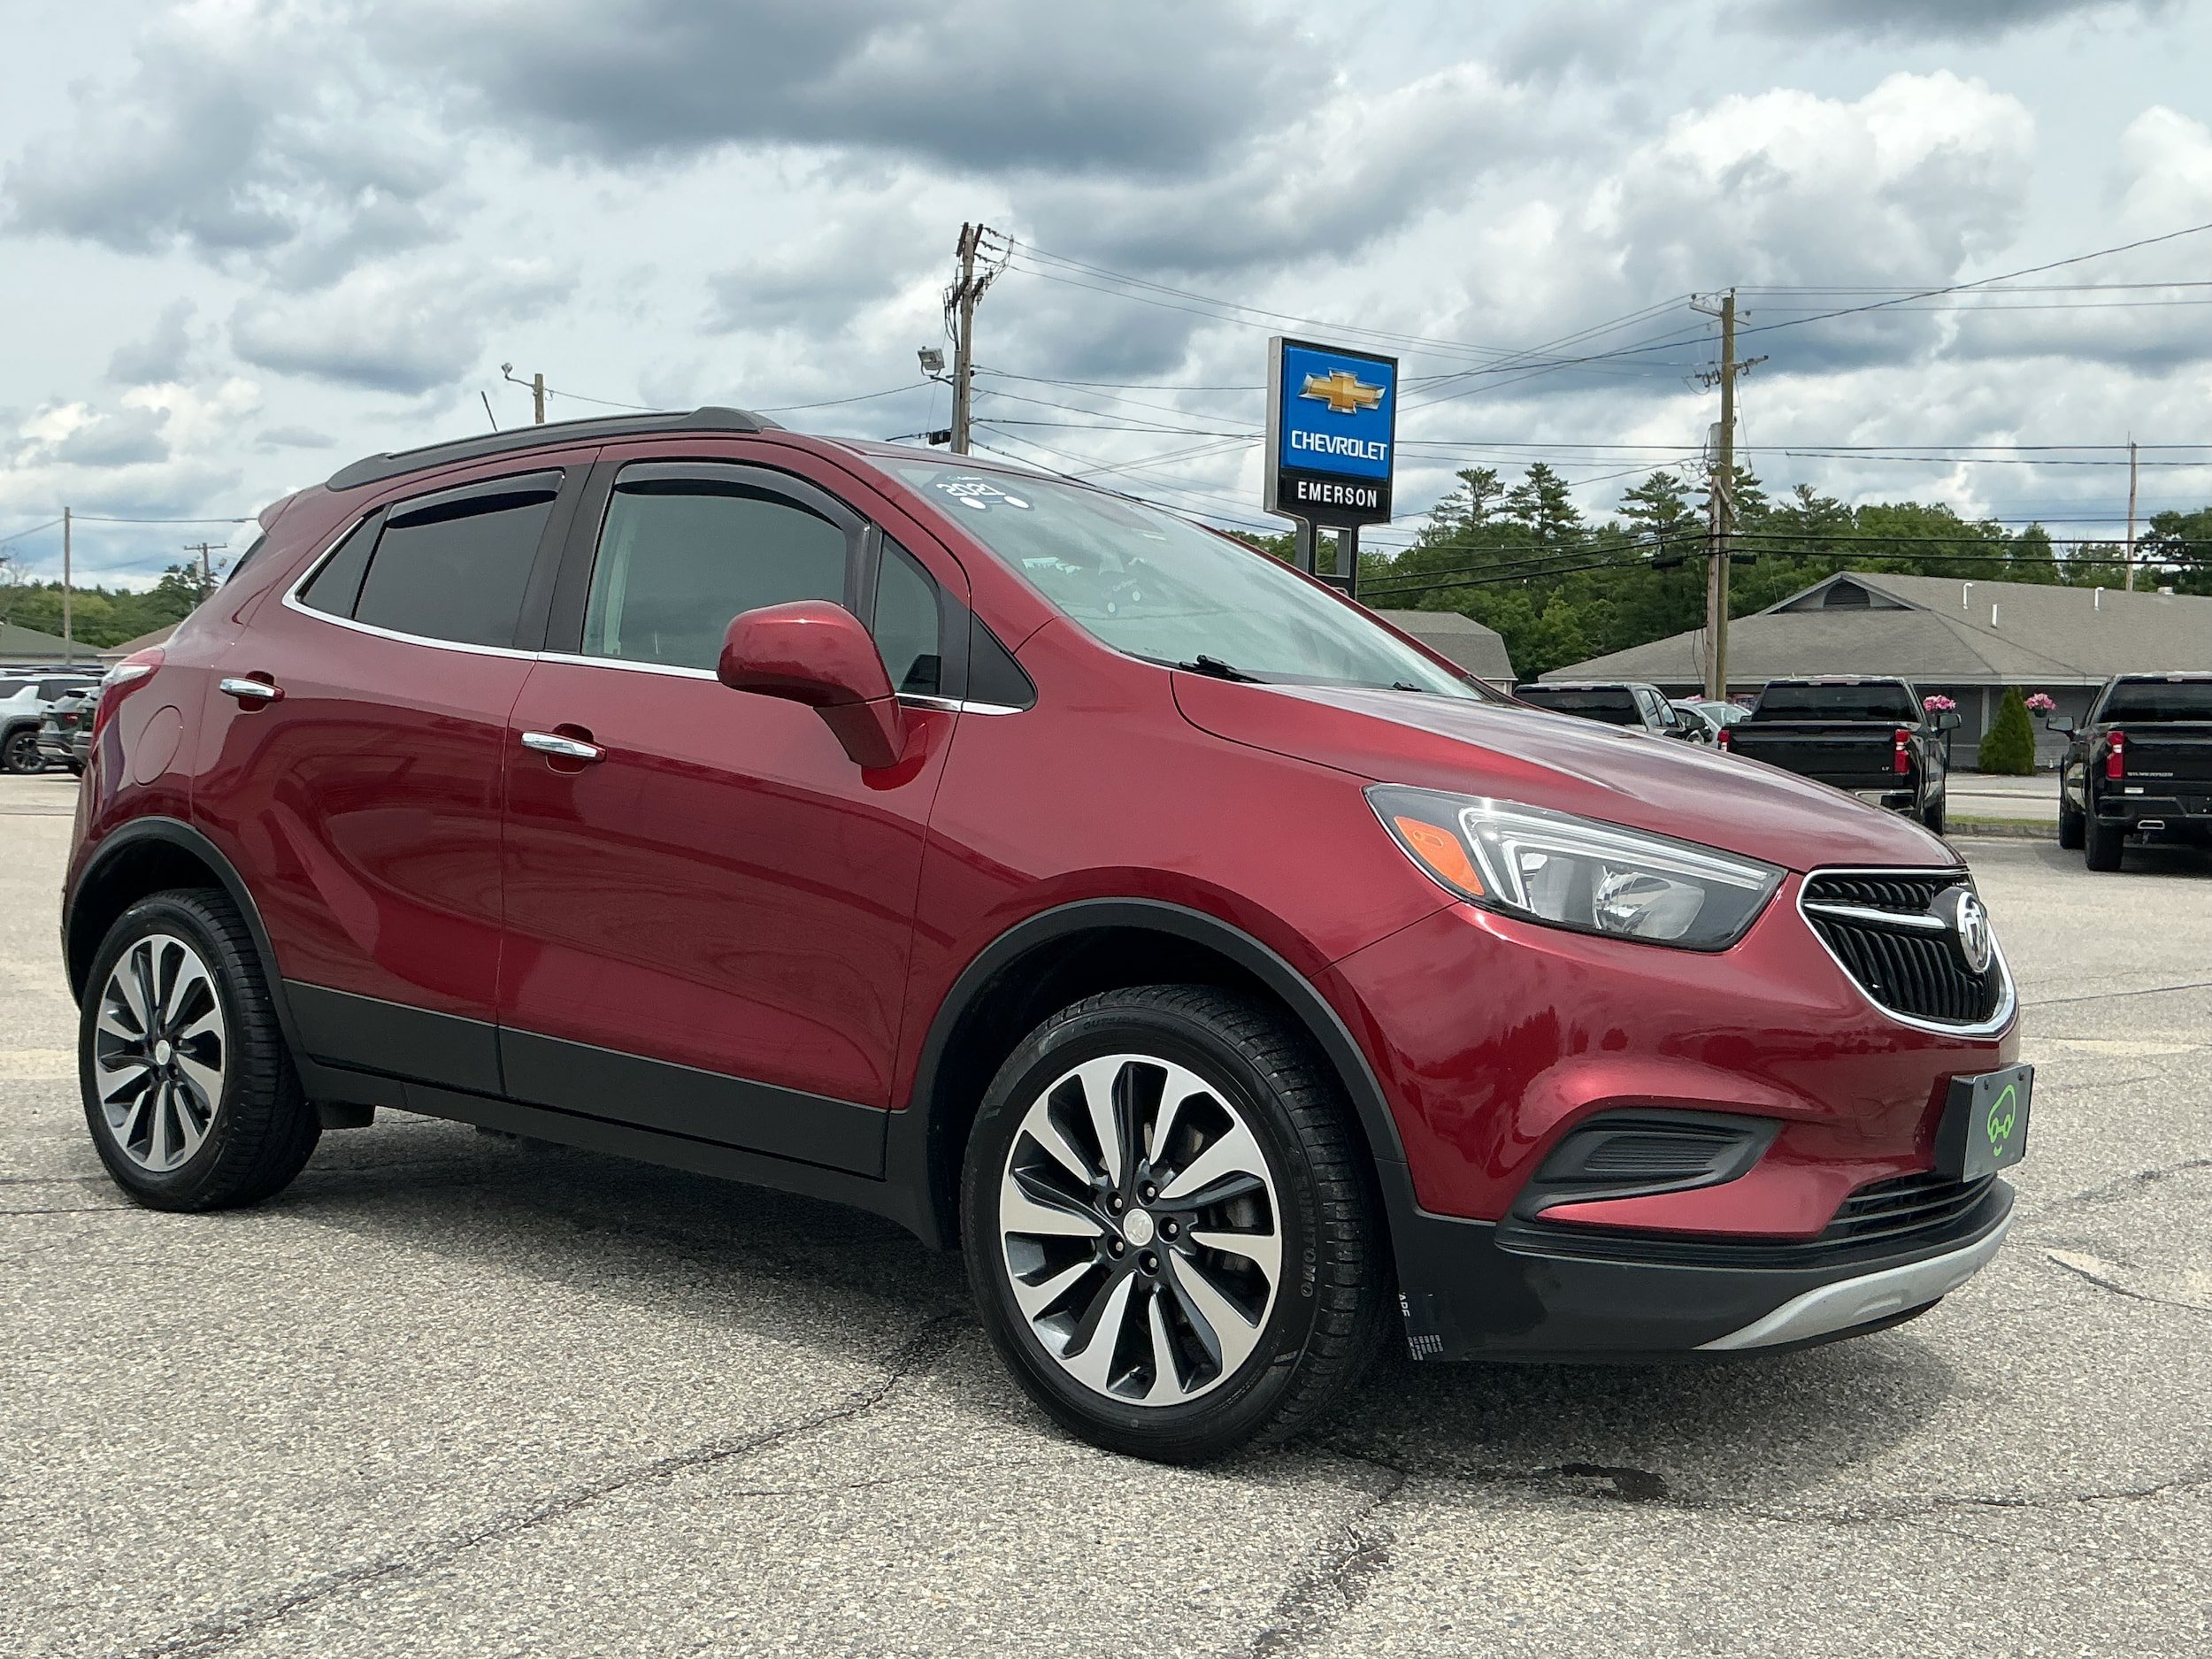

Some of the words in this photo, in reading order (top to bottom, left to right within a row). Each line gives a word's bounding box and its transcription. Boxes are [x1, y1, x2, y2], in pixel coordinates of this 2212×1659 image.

[1291, 430, 1387, 461] CHEVROLET
[935, 482, 1007, 497] 2021
[1297, 480, 1377, 509] EMERSON
